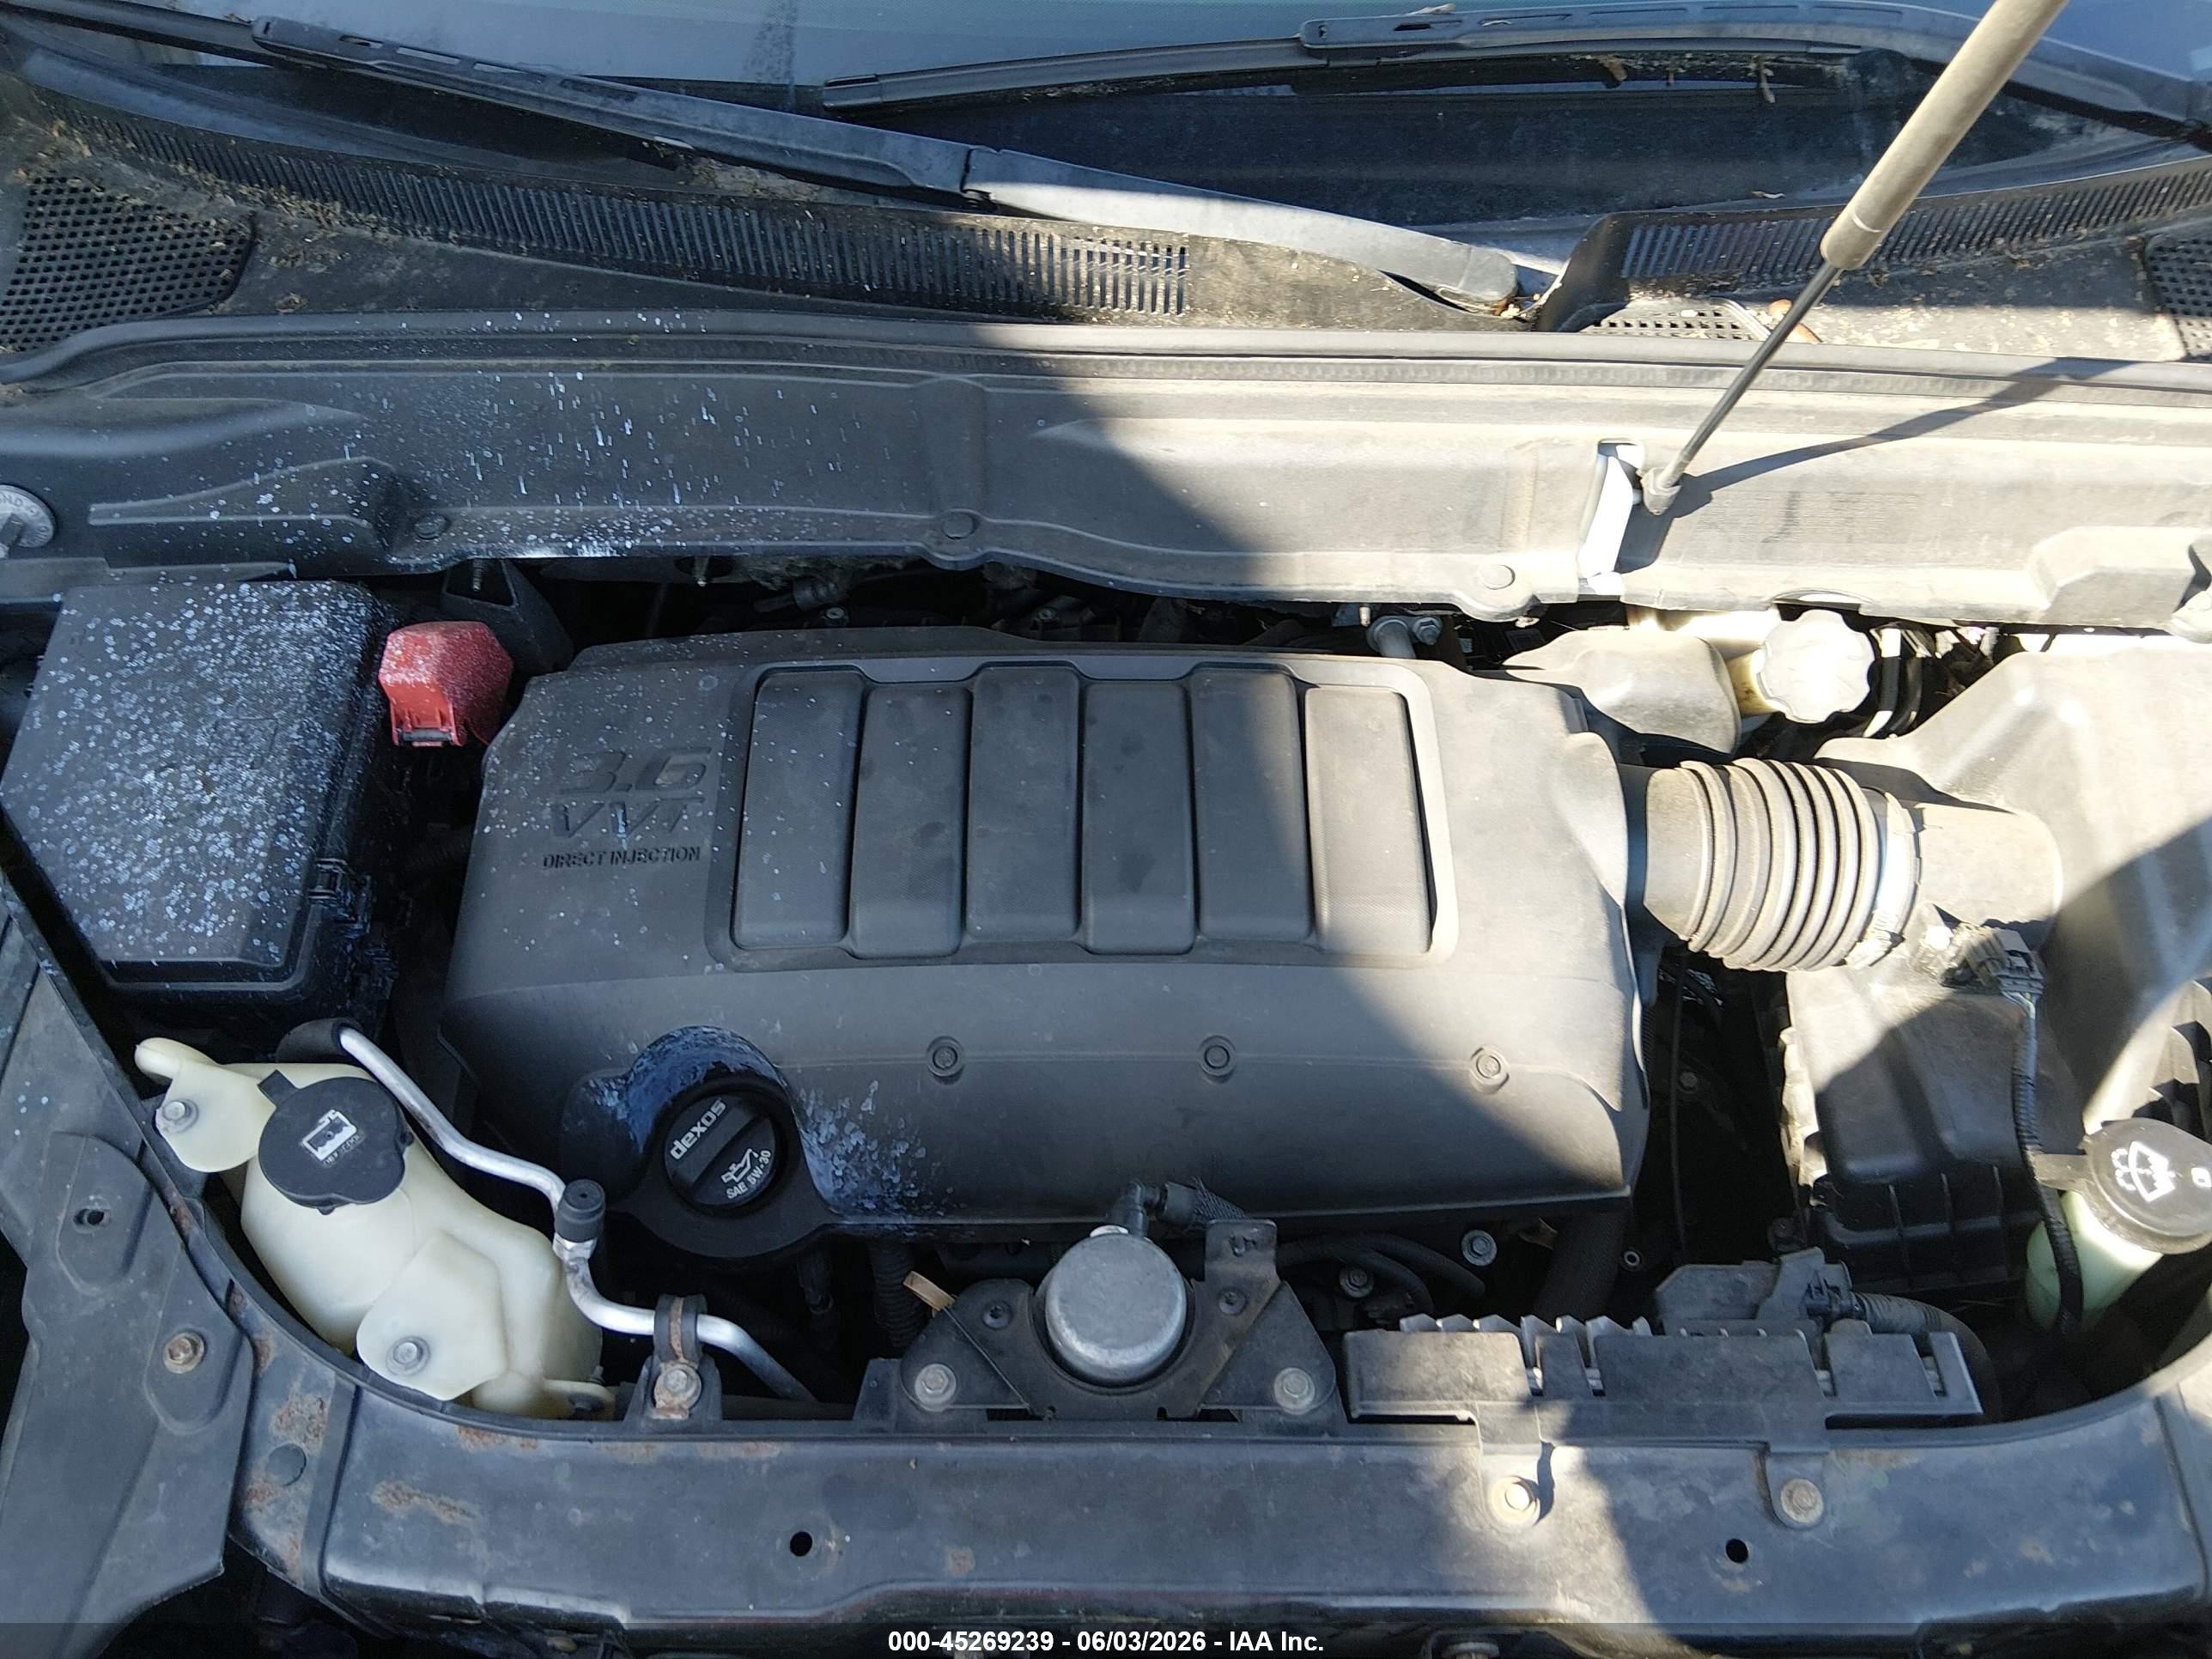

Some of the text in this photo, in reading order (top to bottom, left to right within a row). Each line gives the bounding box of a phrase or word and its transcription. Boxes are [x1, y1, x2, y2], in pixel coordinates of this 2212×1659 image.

[559, 746, 713, 793] 3.6
[552, 796, 706, 838] VVT
[542, 846, 701, 869] DIRECT INJECTION
[671, 1099, 726, 1159] dexos
[726, 1150, 771, 1199] SAE 5W-30
